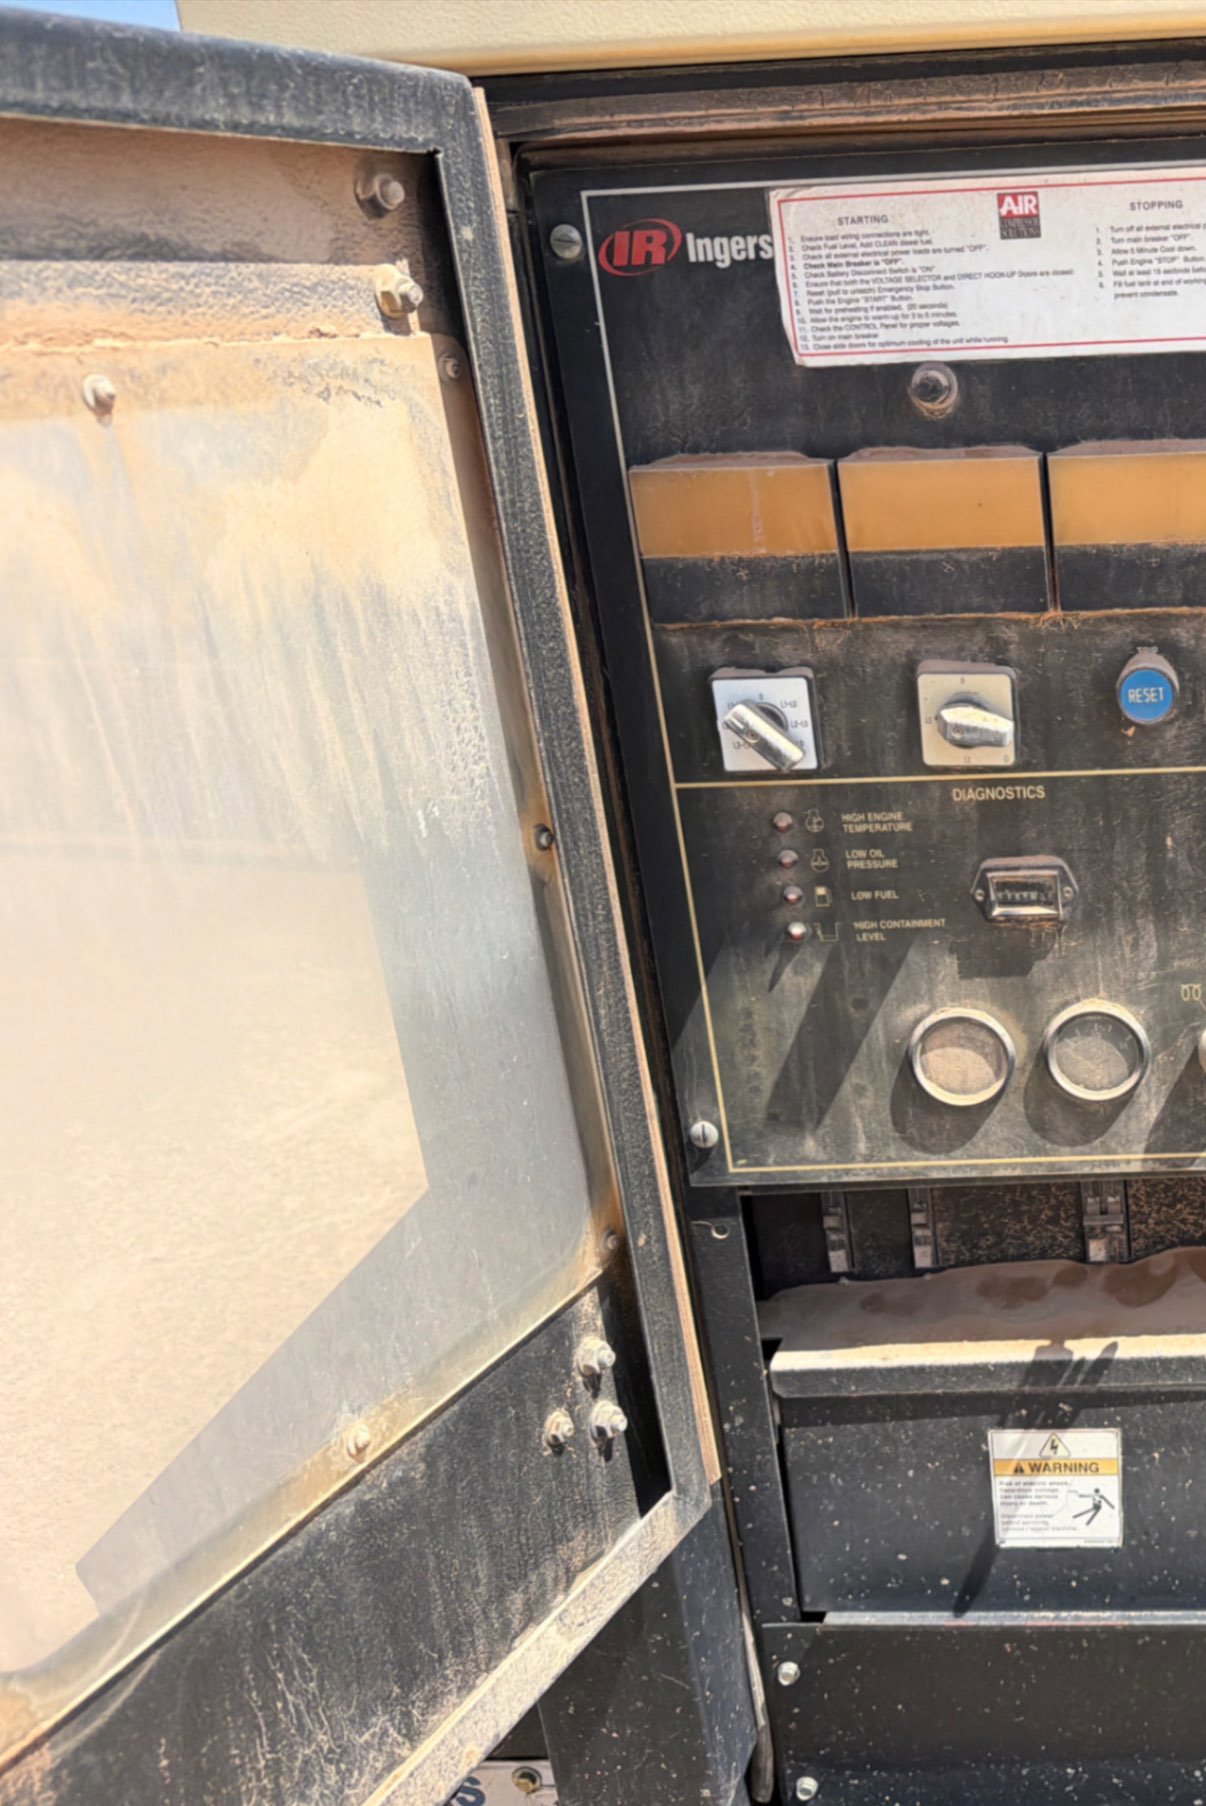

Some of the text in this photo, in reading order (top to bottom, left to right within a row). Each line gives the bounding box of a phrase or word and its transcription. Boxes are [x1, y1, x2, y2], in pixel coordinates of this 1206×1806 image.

[999, 195, 1038, 216] AIR
[1130, 200, 1184, 211] STOPPING
[837, 215, 889, 226] STARTING
[686, 232, 774, 269] Ingers
[1128, 687, 1164, 703] RESET
[952, 785, 1045, 801] DIAGNOSTICS
[841, 811, 903, 823] HIGH ENGINE
[843, 822, 913, 833] TEMPERATURE
[846, 849, 885, 859] LOW OIL
[847, 859, 898, 869] PRESSURE
[851, 890, 899, 900] LOW FUEL
[853, 918, 946, 930] HIGH CONTAINMENT
[856, 932, 886, 942] LEVEL
[1028, 1462, 1100, 1473] WARNING
